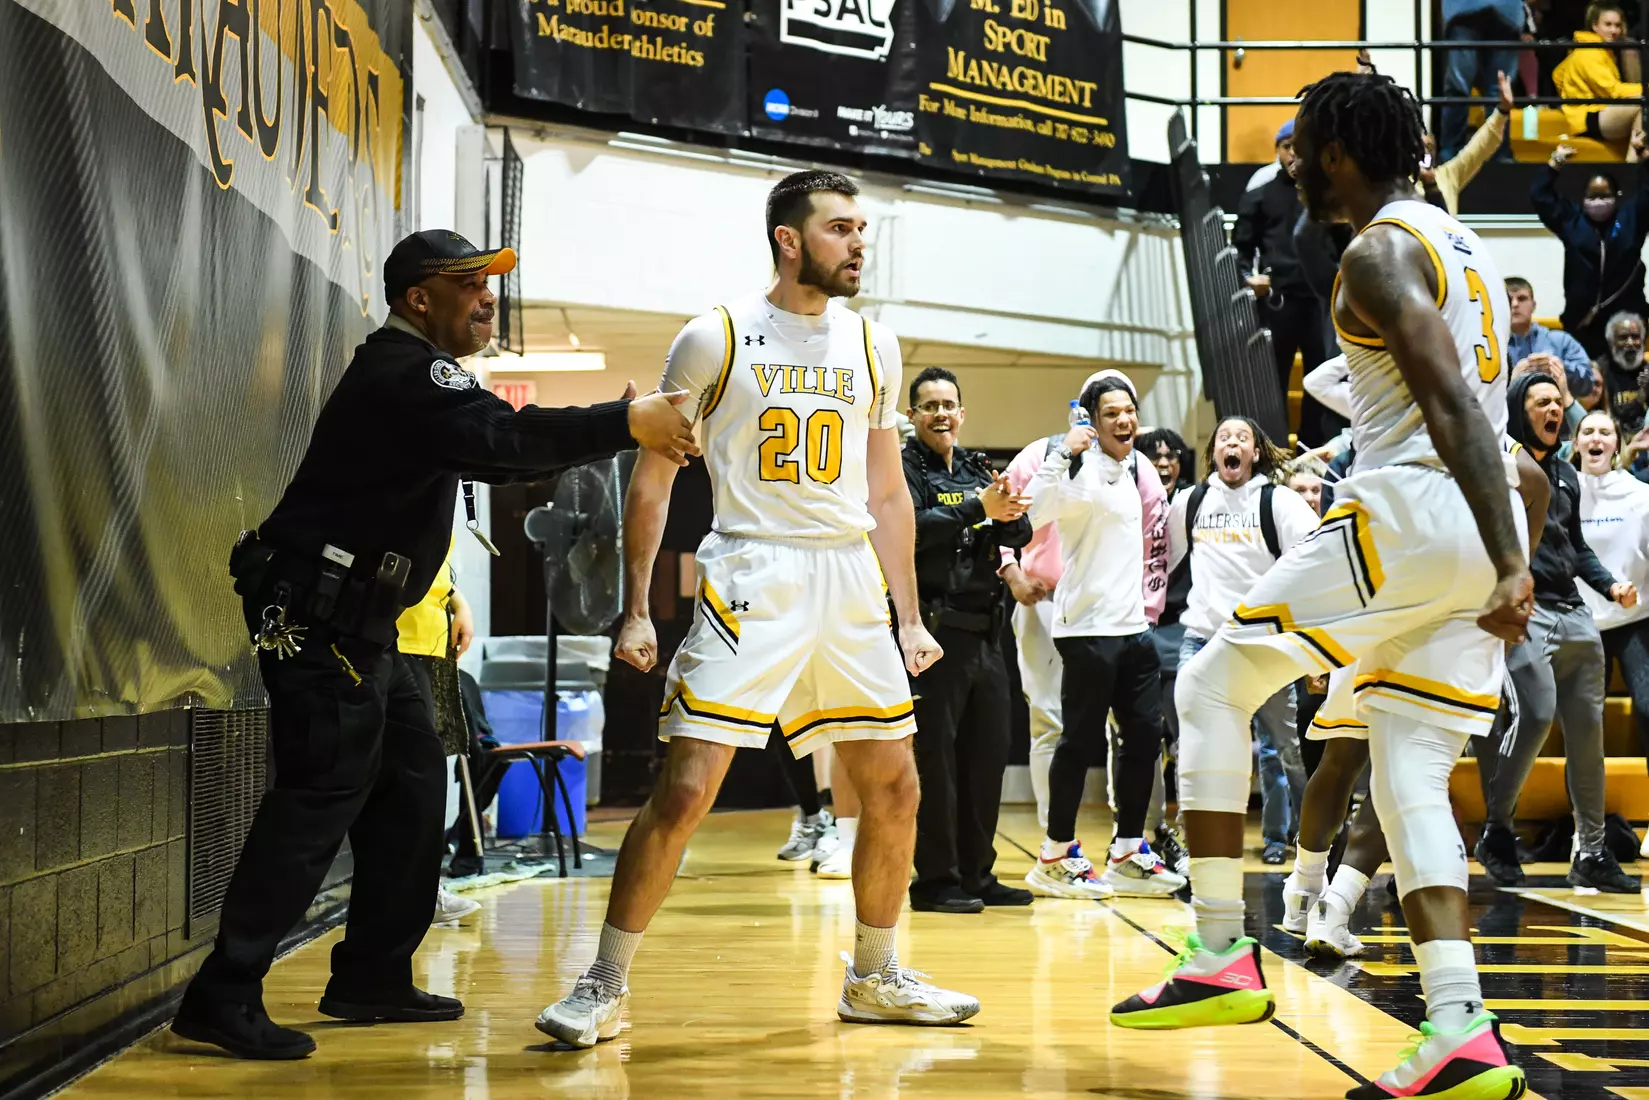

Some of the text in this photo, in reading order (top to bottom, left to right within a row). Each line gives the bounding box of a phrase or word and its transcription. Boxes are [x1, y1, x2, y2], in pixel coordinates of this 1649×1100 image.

[693, 14, 715, 37] of
[1044, 0, 1067, 30] in
[630, 35, 705, 67] thletics
[983, 19, 1051, 62] SPORT
[946, 46, 1098, 108] MANAGEMENT
[1464, 265, 1501, 384] 3
[751, 363, 855, 405] VILLE
[758, 406, 844, 485] 20
[937, 492, 964, 506] POLICE
